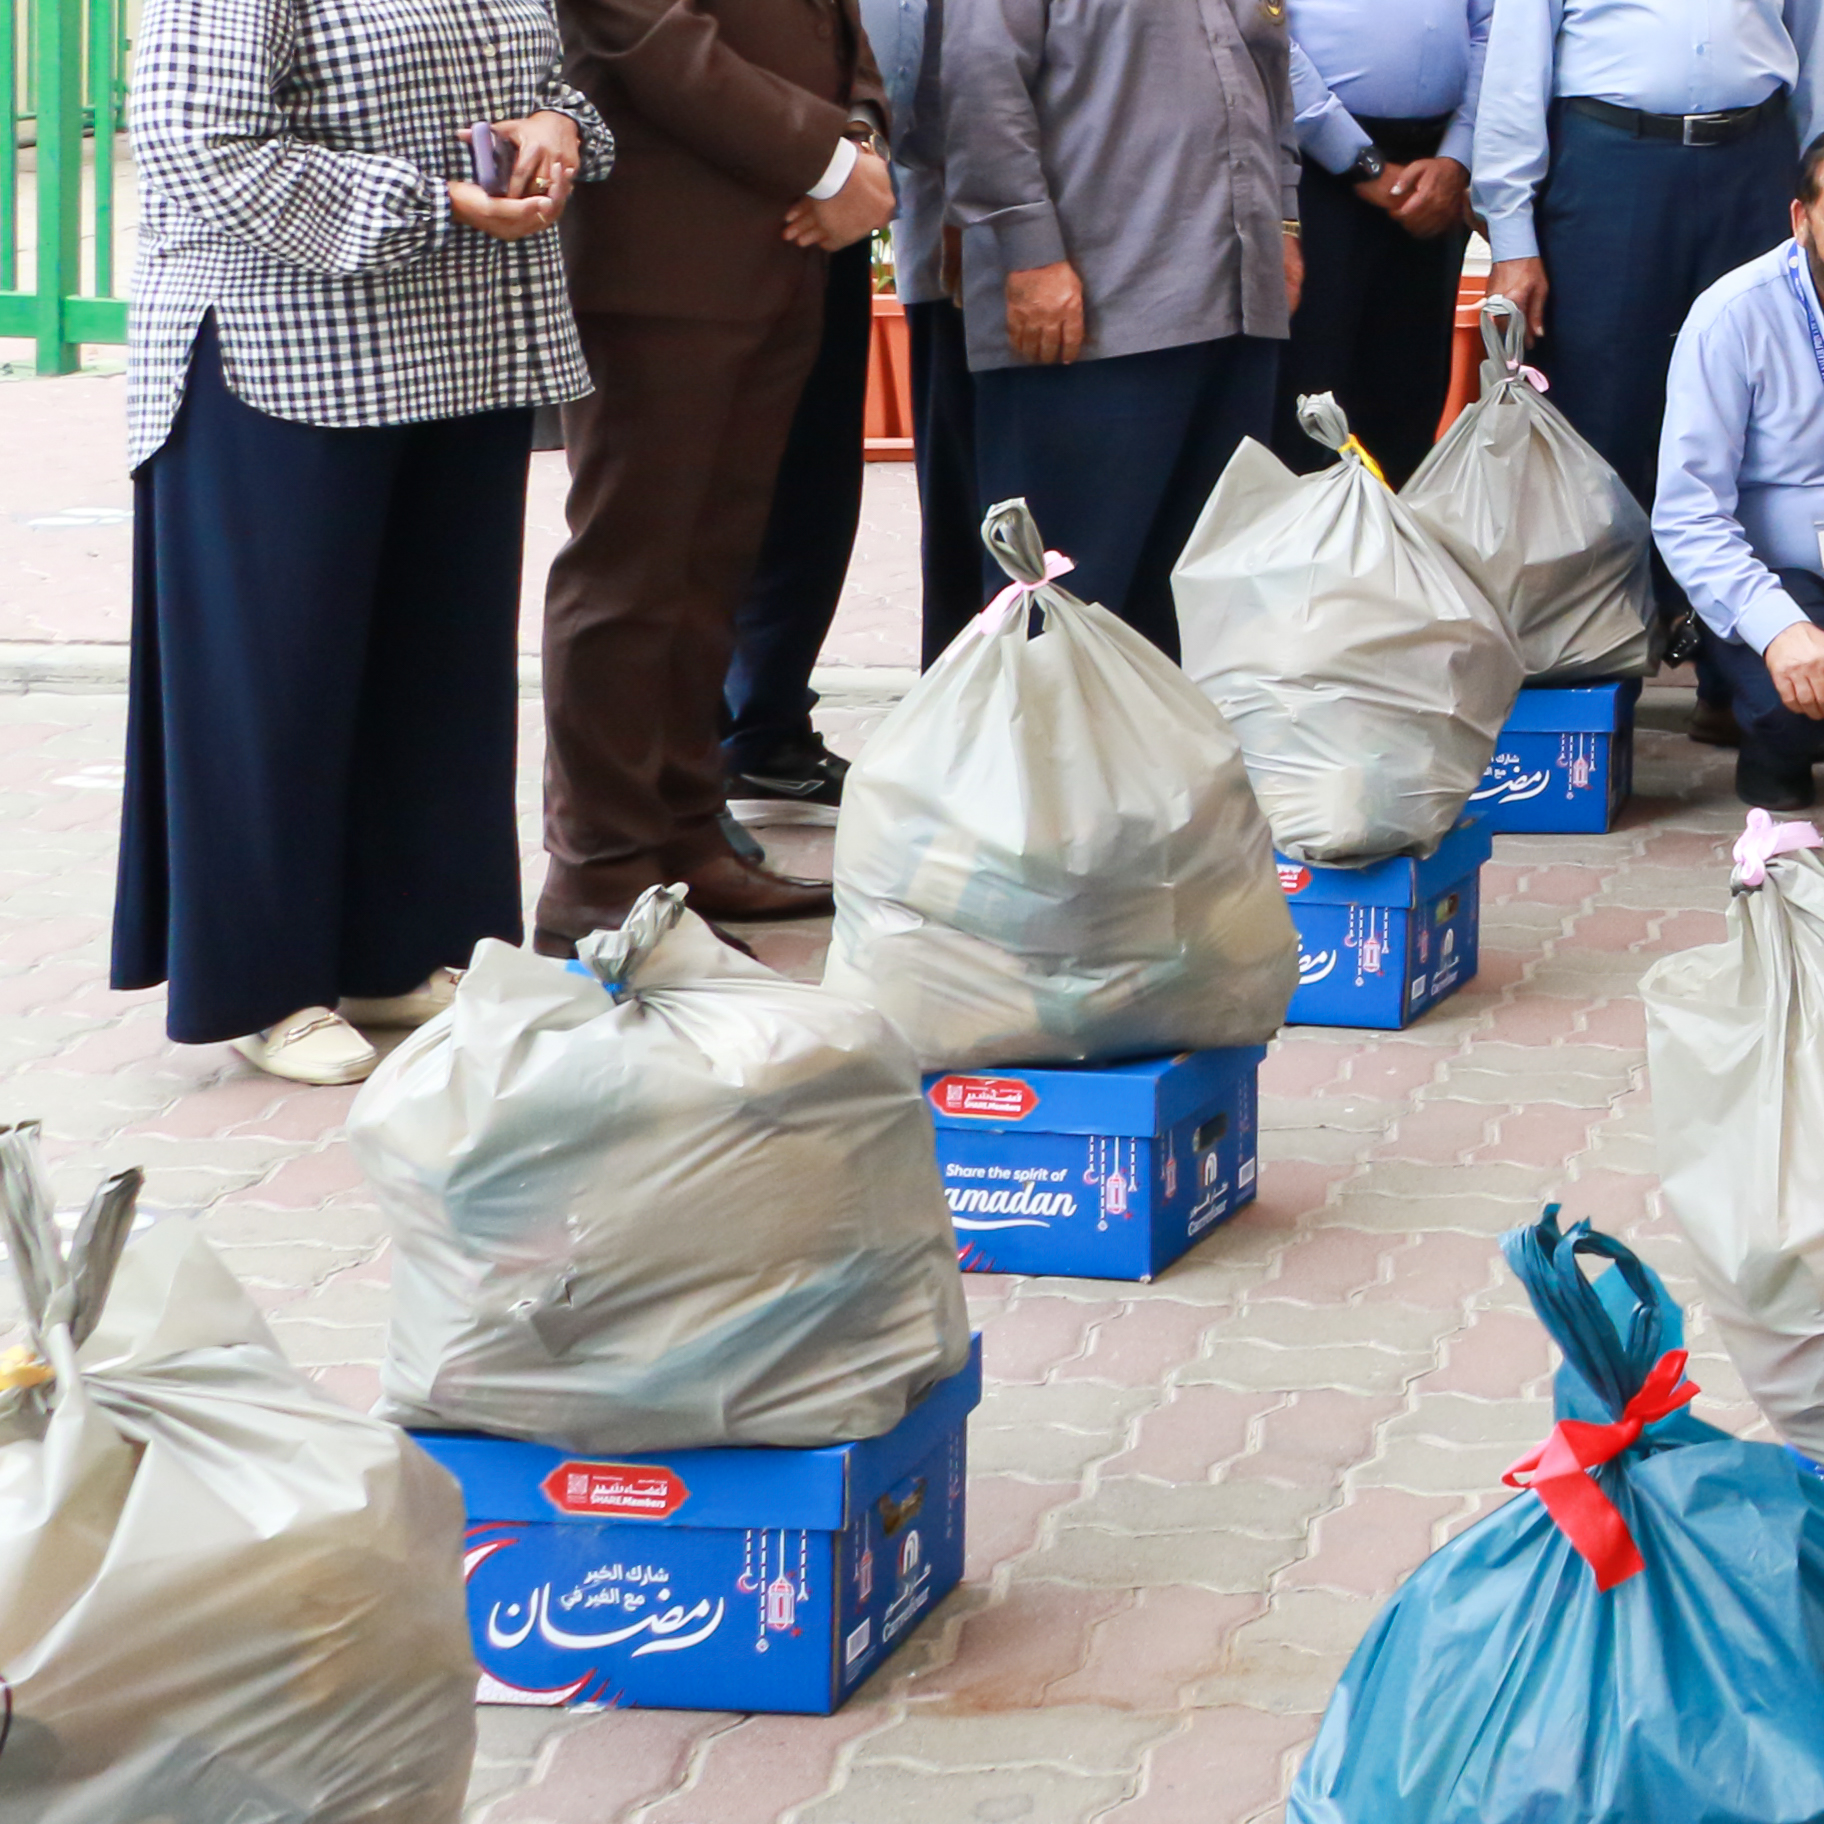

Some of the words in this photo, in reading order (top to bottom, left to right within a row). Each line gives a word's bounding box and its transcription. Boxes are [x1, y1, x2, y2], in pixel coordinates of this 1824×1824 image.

[1495, 754, 1520, 765] شارك
[1468, 766, 1550, 804] رمض
[946, 1163, 986, 1177] Share
[988, 1166, 1011, 1179] the
[1013, 1168, 1049, 1183] spirit
[1050, 1168, 1068, 1182] of
[944, 1180, 1078, 1217] amadan
[583, 1564, 623, 1584] الخير
[626, 1565, 669, 1586] شارك
[560, 1586, 583, 1611] في
[583, 1588, 620, 1608] الغير
[623, 1592, 645, 1611] مع
[488, 1581, 724, 1658] رمضان
